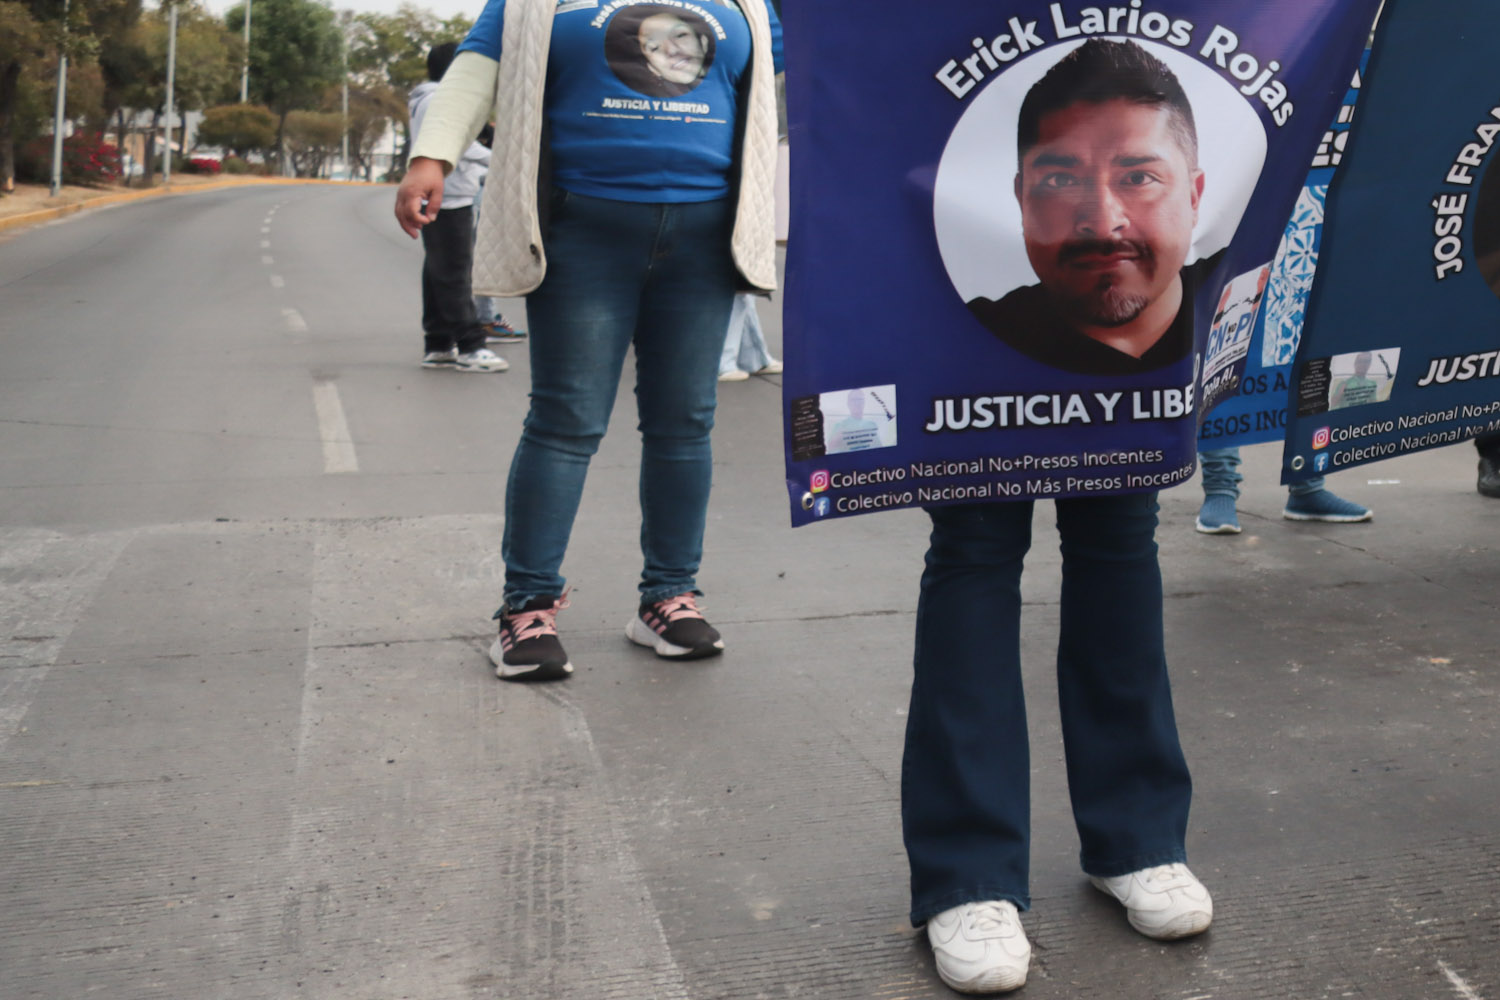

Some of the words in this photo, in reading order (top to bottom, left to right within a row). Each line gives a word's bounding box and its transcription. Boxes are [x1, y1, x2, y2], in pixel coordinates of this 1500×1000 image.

[935, 16, 1046, 99] Erick
[1200, 25, 1294, 127] Rojas
[602, 98, 651, 110] JUSTICIA
[652, 101, 660, 111] Y
[662, 102, 710, 114] LIBERTAD
[1432, 193, 1467, 280] JOSÉ
[926, 394, 1091, 431] JUSTICIA
[1094, 392, 1122, 421] Y
[1133, 383, 1194, 419] LIBE
[1330, 419, 1394, 443] Colectivo
[1398, 408, 1458, 430] Nacional
[1332, 442, 1396, 467] Colectivo
[1399, 428, 1460, 452] Nacional
[1464, 422, 1483, 437] No
[830, 466, 906, 488] Colectivo
[910, 458, 983, 479] Nacional
[989, 454, 1079, 473] No+Presos
[1083, 449, 1163, 466] Inocentes
[836, 491, 912, 513] Colectivo
[918, 483, 991, 501] Nacional
[997, 482, 1021, 497] No
[1026, 478, 1062, 494] Más
[1067, 476, 1122, 491] Presos
[1127, 463, 1193, 488] Inocentes
